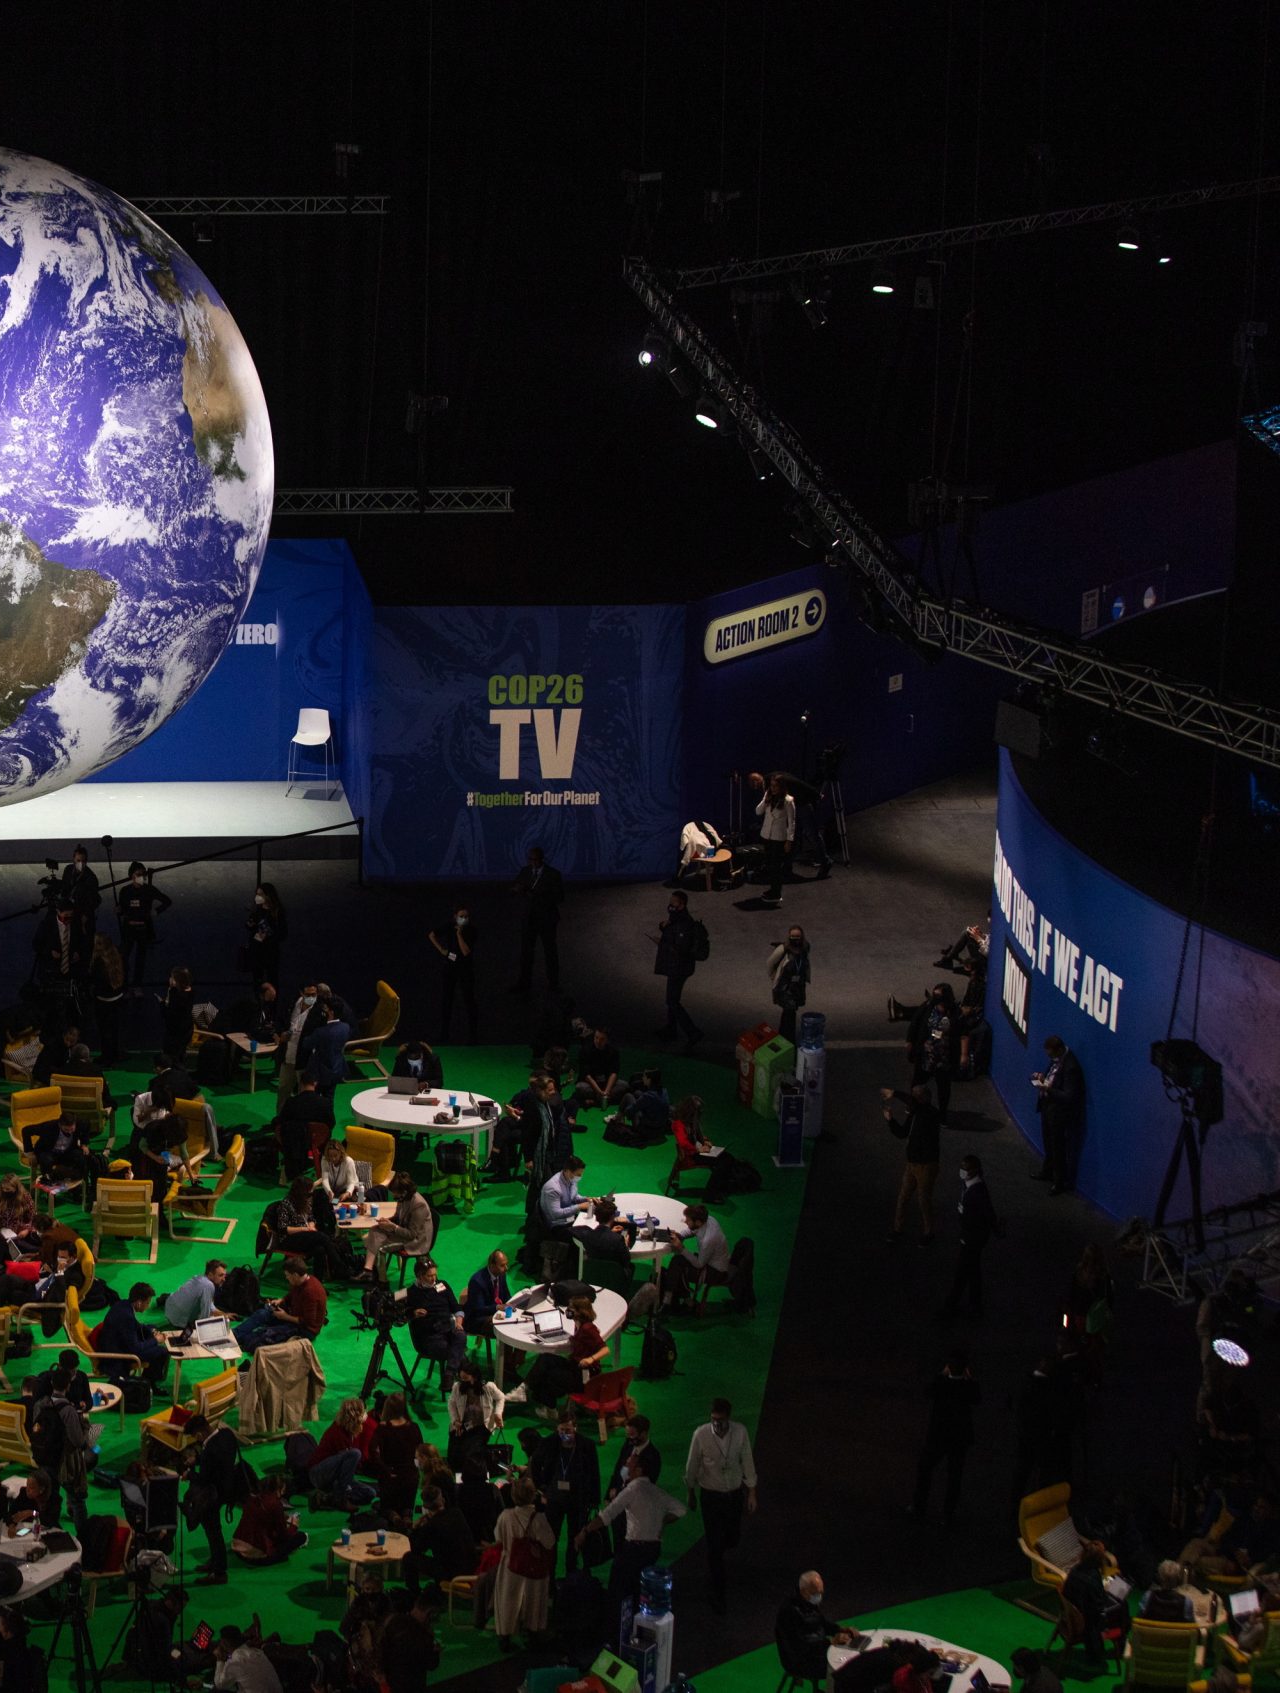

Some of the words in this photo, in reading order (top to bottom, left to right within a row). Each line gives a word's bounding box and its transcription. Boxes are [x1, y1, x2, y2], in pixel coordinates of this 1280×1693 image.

[236, 623, 279, 646] ZERO
[715, 619, 756, 653] ACTION
[758, 608, 790, 640] ROOM
[791, 605, 799, 630] 2
[487, 673, 584, 705] COP26
[489, 707, 583, 780] TV
[466, 790, 600, 808] #TogetherForOurPlanet
[1012, 876, 1037, 971] THIS,
[1037, 912, 1053, 977] IF
[1053, 927, 1081, 1004] WE
[1078, 953, 1124, 1034] ACT
[1002, 945, 1028, 1035] NOW.
